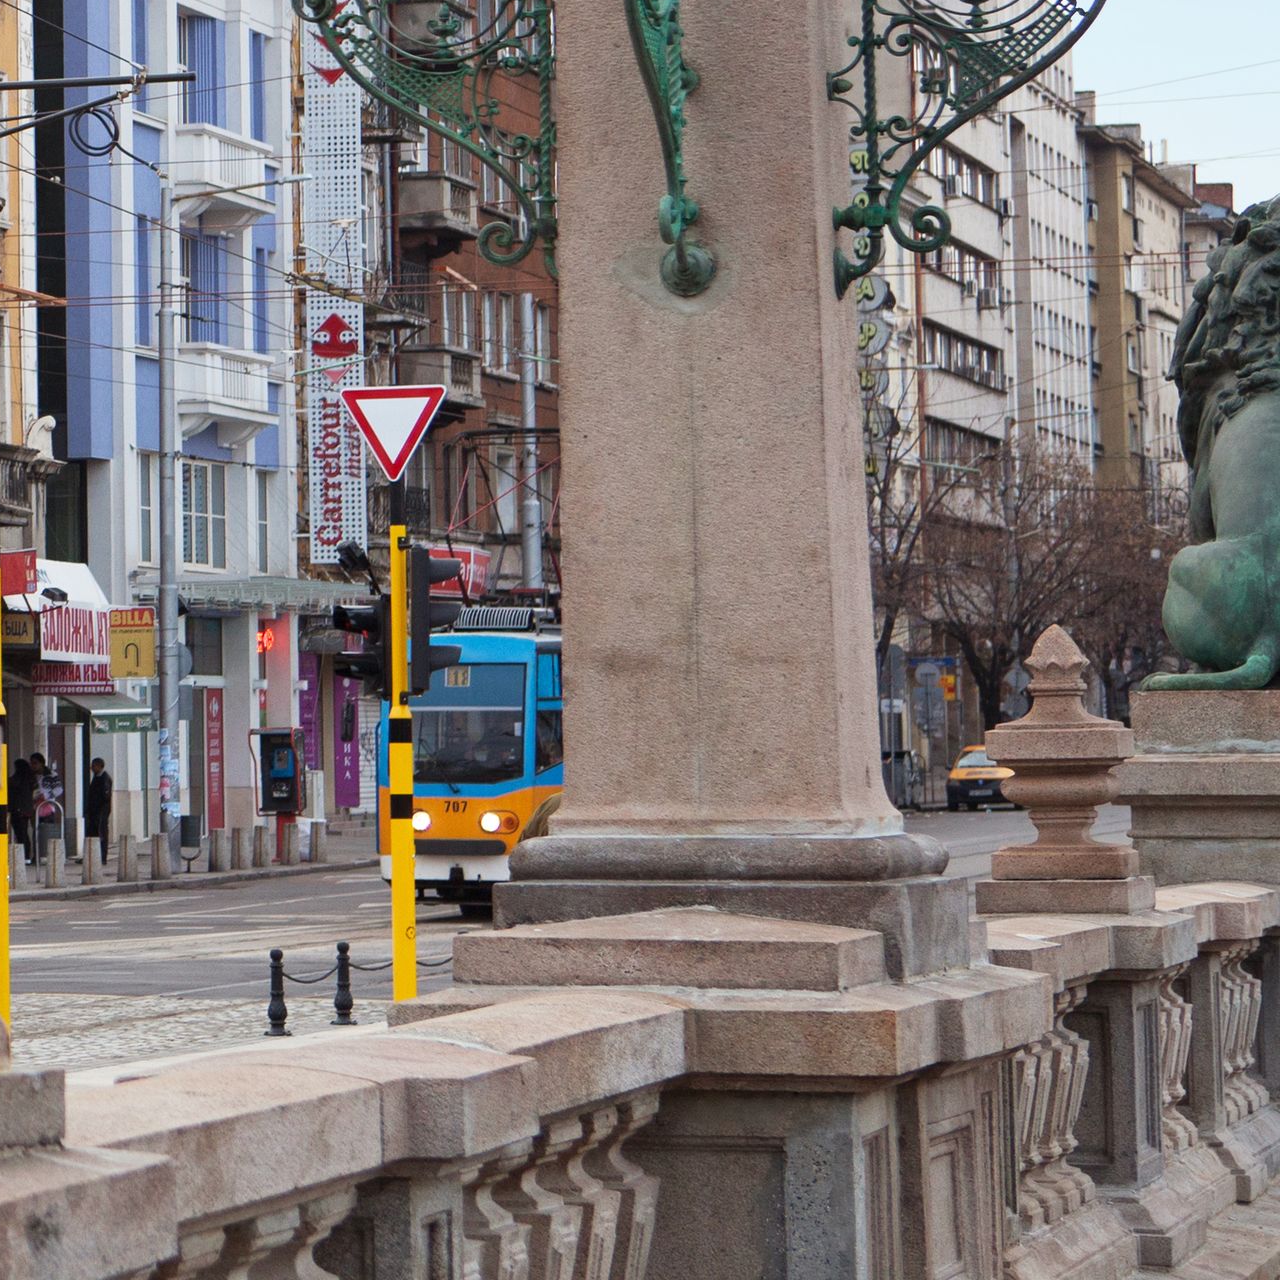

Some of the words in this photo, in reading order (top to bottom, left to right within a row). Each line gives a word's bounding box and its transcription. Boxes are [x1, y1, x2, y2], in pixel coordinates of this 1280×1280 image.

[345, 416, 361, 479] mark
[313, 397, 344, 547] Carrefour
[111, 611, 152, 626] BILLA
[2, 621, 28, 638] ЪЩА
[42, 604, 95, 654] ЗАЛОЖНА
[32, 664, 81, 682] ЗАЛОЖНА
[83, 664, 109, 683] КЪЩ
[444, 800, 468, 813] 707
